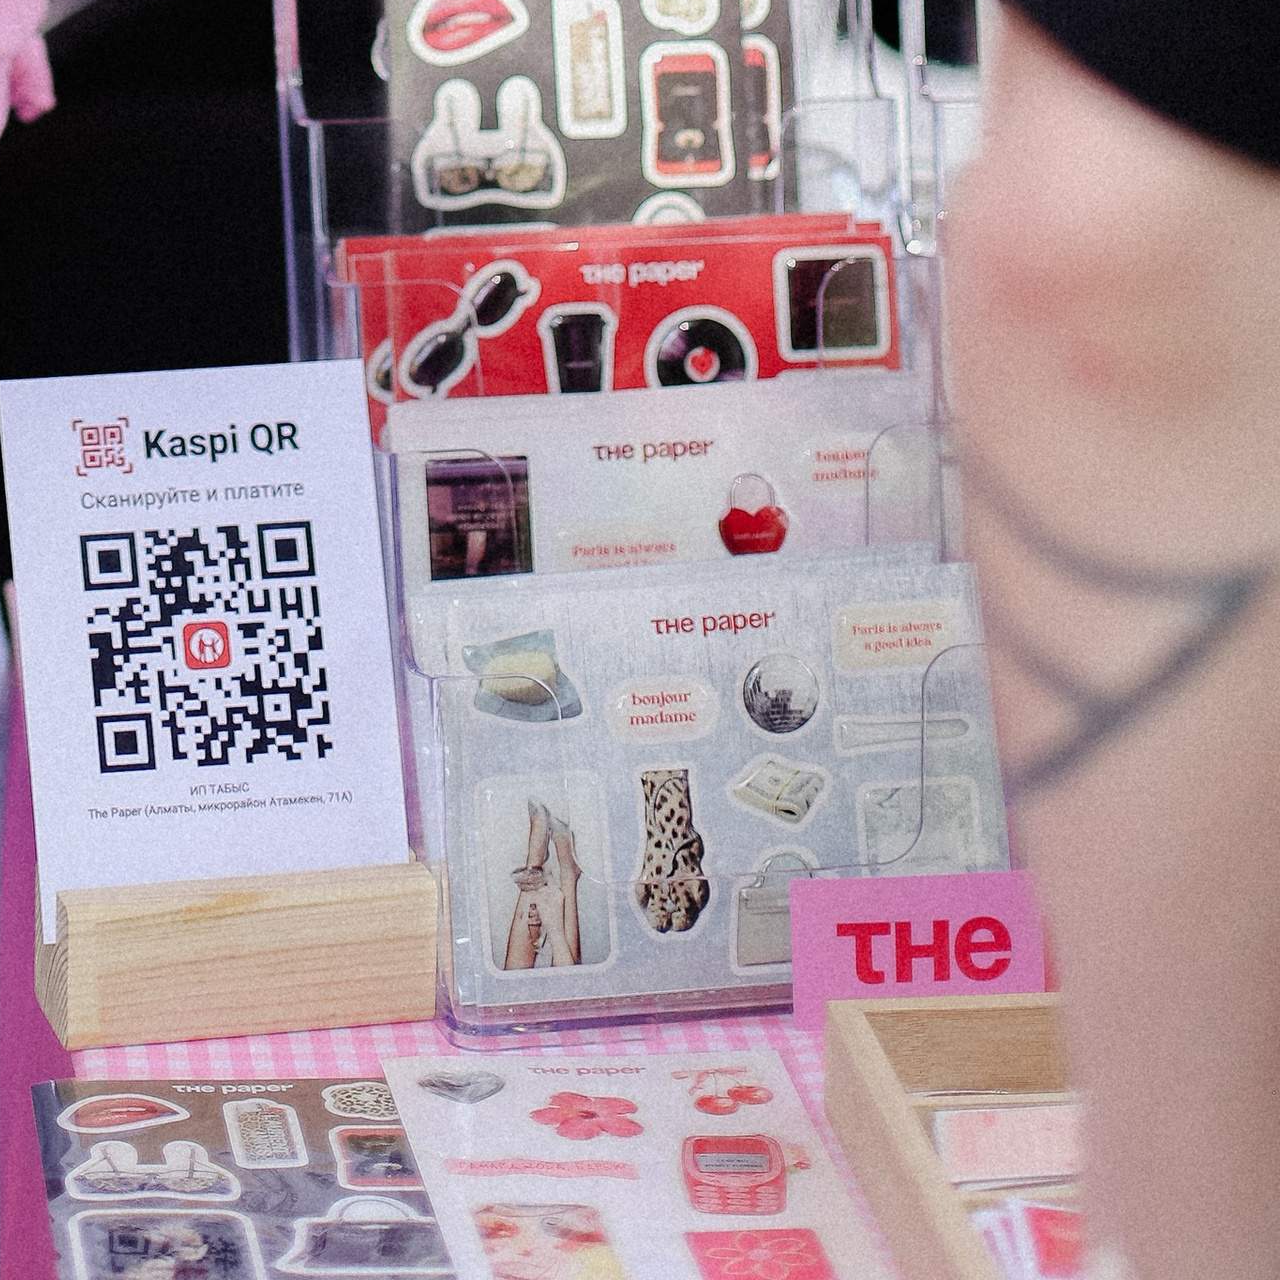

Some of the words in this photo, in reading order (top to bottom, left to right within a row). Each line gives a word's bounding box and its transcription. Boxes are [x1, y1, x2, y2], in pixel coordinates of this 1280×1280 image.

[628, 259, 706, 288] paper
[144, 424, 238, 463] Kaspi
[250, 421, 299, 455] QR
[643, 439, 714, 463] paper
[80, 486, 201, 511] Сканируйте
[206, 488, 219, 503] и
[224, 481, 305, 502] платите
[702, 611, 776, 637] paper
[852, 623, 885, 635] Paris
[888, 622, 898, 633] is
[901, 621, 943, 634] always
[874, 638, 903, 653] good
[906, 637, 932, 648] idea
[631, 691, 691, 708] bonjour
[630, 711, 697, 725] madame
[189, 784, 208, 796] ИП
[209, 781, 251, 794] ТАБЫС
[88, 807, 109, 819] The
[111, 806, 141, 820] Paper
[144, 804, 196, 818] (Алматы,
[198, 798, 267, 814] микрорайон
[270, 795, 326, 808] Атамекен,
[576, 1065, 646, 1077] paper
[221, 1083, 294, 1095] paper
